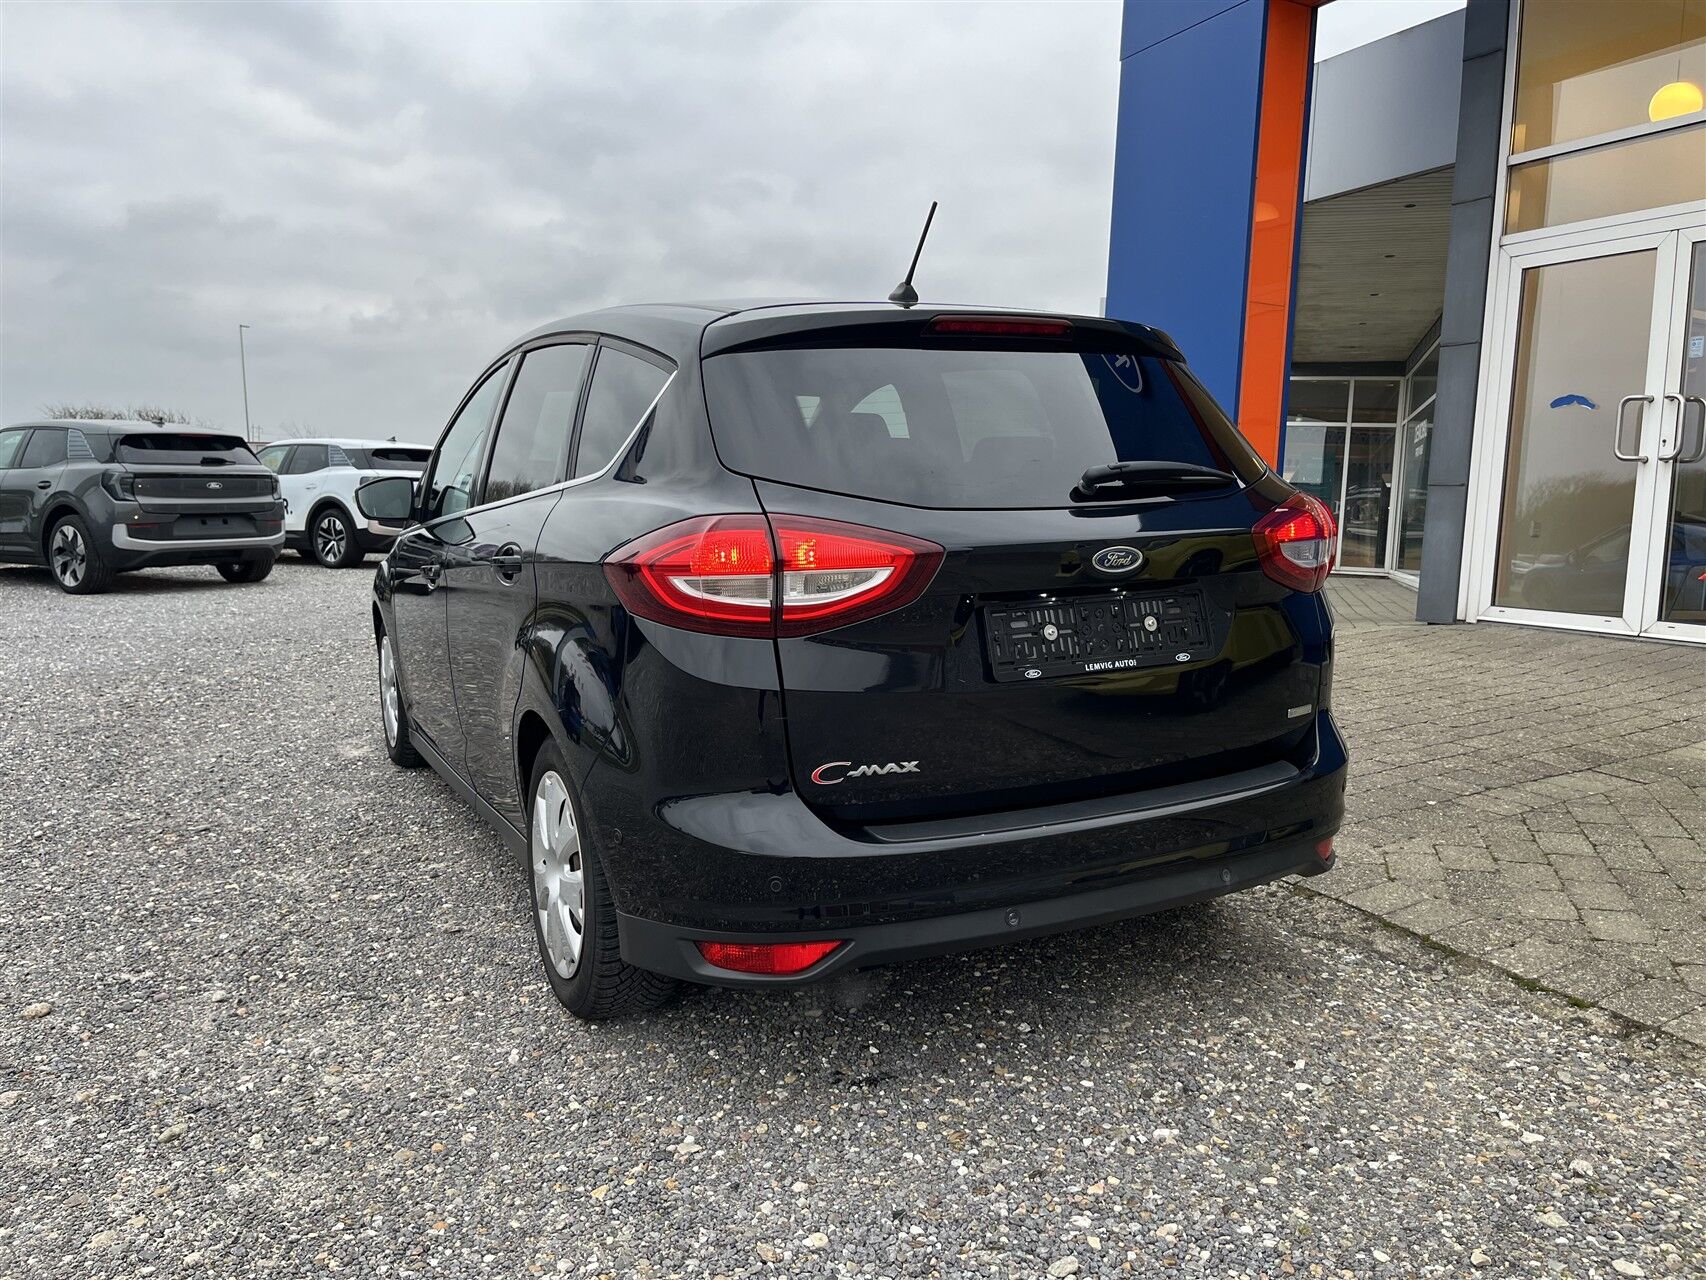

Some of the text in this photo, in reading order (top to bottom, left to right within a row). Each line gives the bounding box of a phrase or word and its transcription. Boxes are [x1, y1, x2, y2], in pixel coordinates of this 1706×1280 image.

[1103, 551, 1133, 567] Ford
[1085, 661, 1113, 671] LEMVIG
[811, 761, 920, 785] C-MAX
